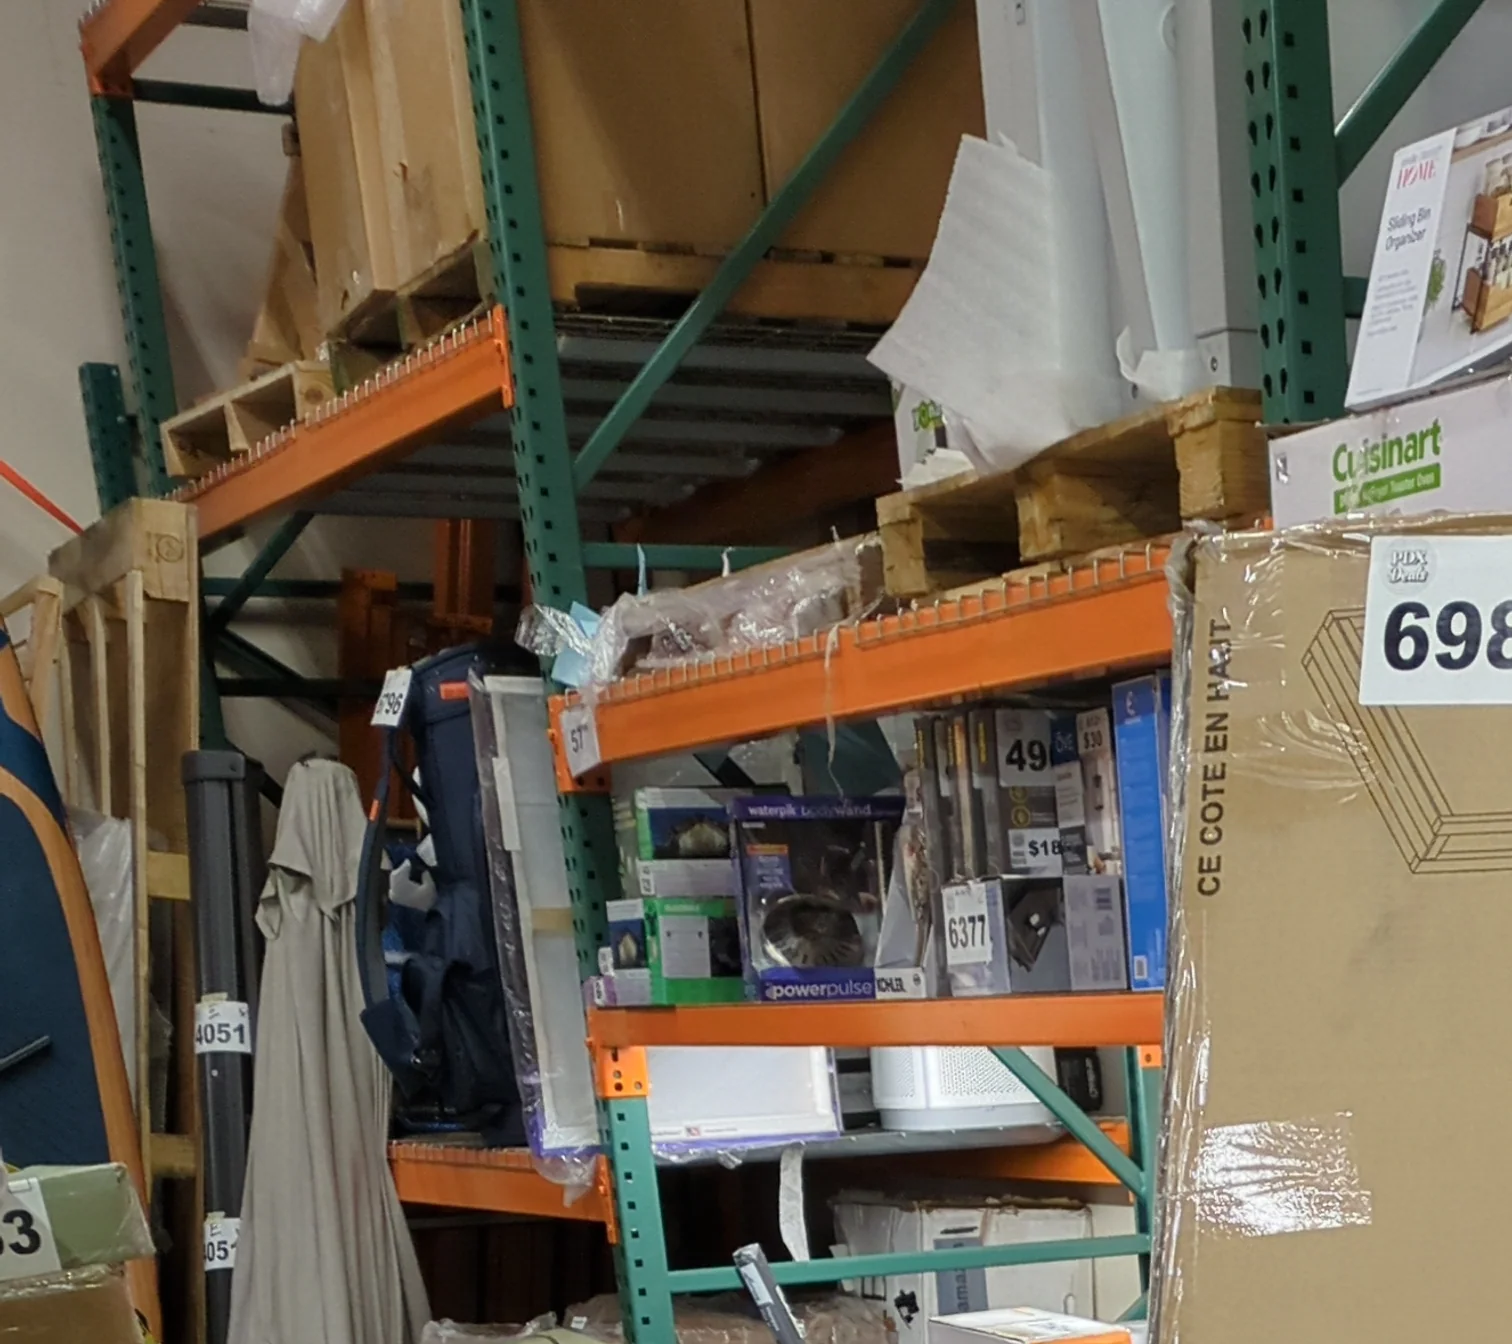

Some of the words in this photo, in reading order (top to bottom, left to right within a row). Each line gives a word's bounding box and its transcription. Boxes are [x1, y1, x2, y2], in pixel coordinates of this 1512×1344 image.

[1397, 159, 1437, 190] HOME
[1387, 211, 1416, 233] Sliding
[1417, 206, 1432, 223] Bin
[1385, 227, 1427, 252] Organizer
[1333, 418, 1442, 483] Cuisinart
[1389, 549, 1428, 566] PDX
[1204, 712, 1229, 753] EN
[748, 803, 796, 819] waterpik
[1200, 762, 1227, 846] COTE
[1197, 855, 1222, 897] CE
[948, 915, 986, 948] 6377
[774, 979, 874, 1001] powerpulse
[0, 1209, 42, 1255] 3
